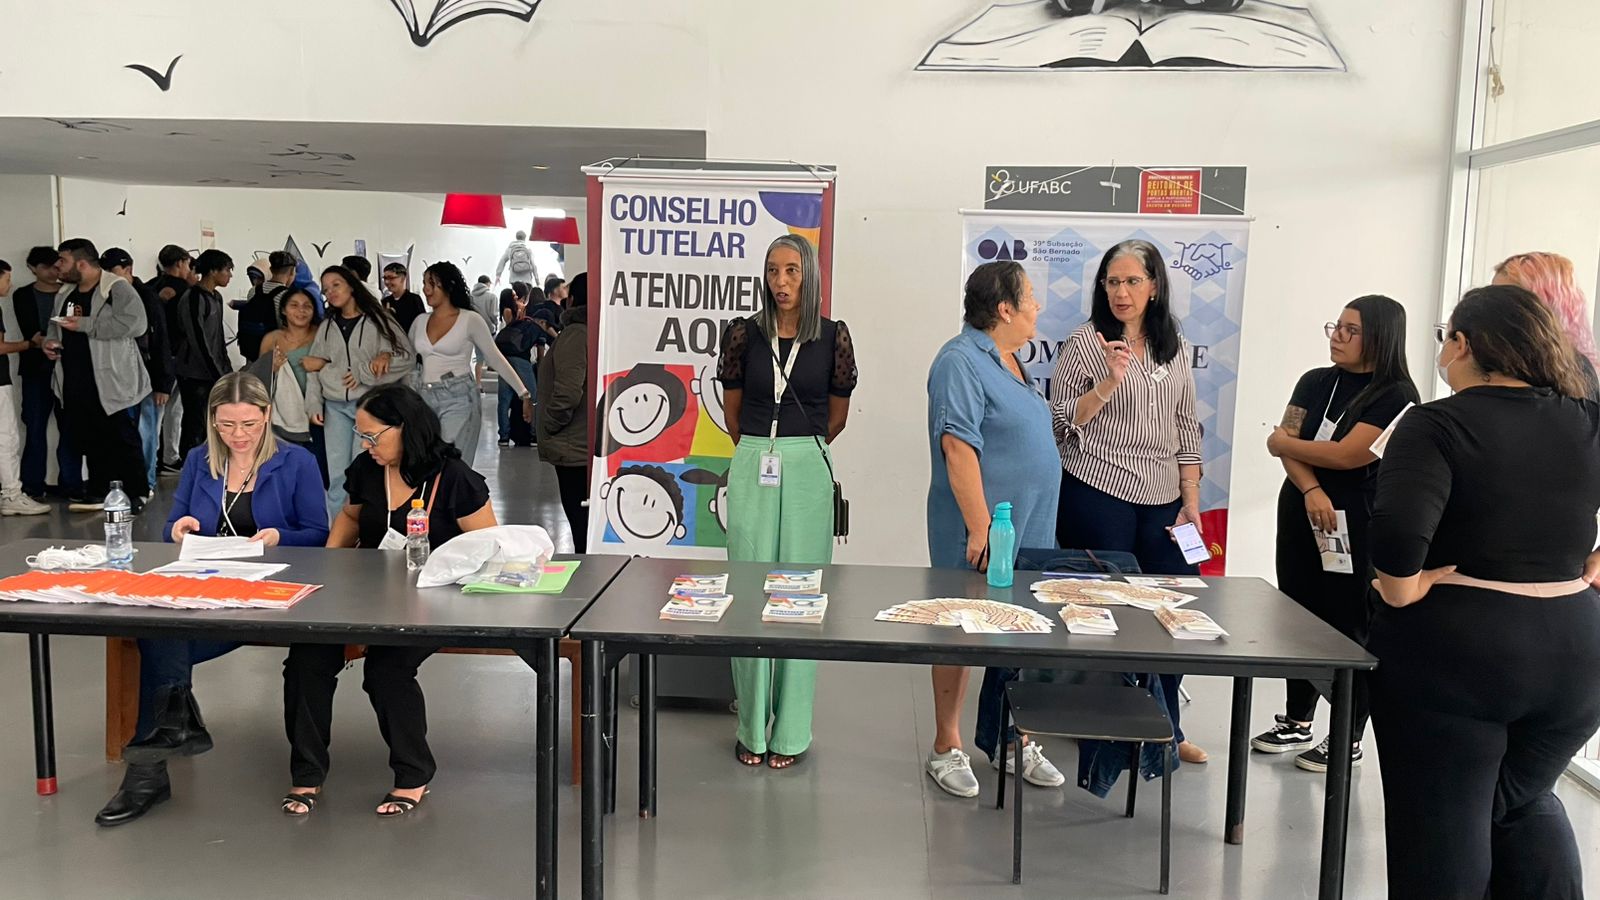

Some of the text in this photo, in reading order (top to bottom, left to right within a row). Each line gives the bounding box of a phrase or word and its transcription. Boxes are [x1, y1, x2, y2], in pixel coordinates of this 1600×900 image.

[1018, 180, 1072, 195] UFABC
[610, 193, 757, 226] CONSELHO
[619, 227, 745, 259] TUTELAR
[978, 239, 1028, 261] OAB
[1047, 240, 1083, 248] Subseção
[609, 271, 764, 312] ATENDIMEN
[655, 317, 729, 358] AQ
[1191, 345, 1209, 369] E
